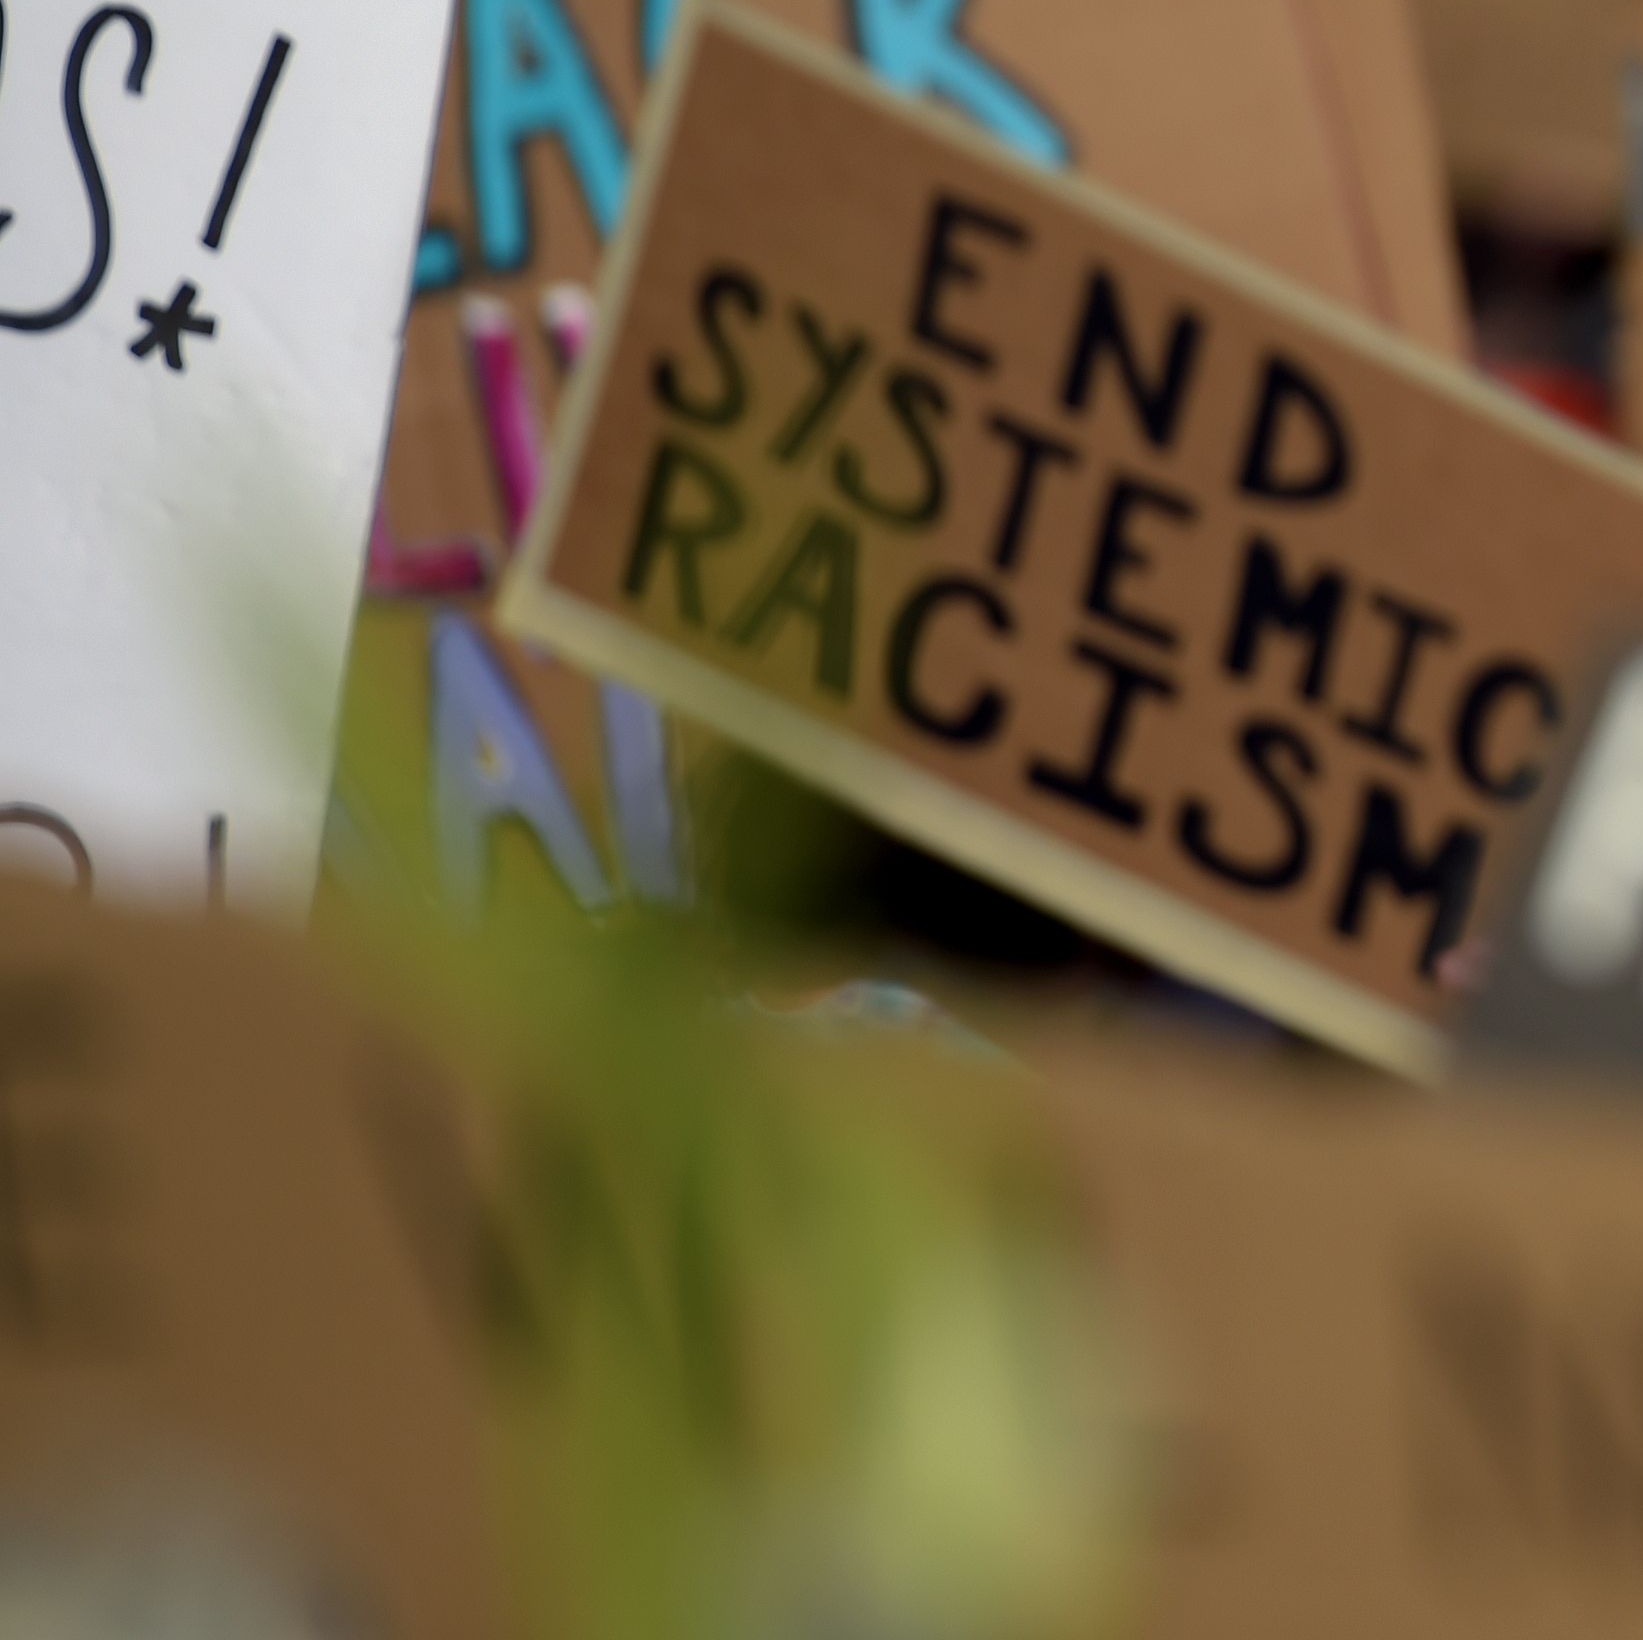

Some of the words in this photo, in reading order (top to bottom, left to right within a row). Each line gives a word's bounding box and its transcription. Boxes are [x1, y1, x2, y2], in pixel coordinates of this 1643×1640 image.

[648, 263, 1563, 803] SYSTEMIC
[905, 190, 1355, 508] END
[622, 435, 1488, 986] RACISM
